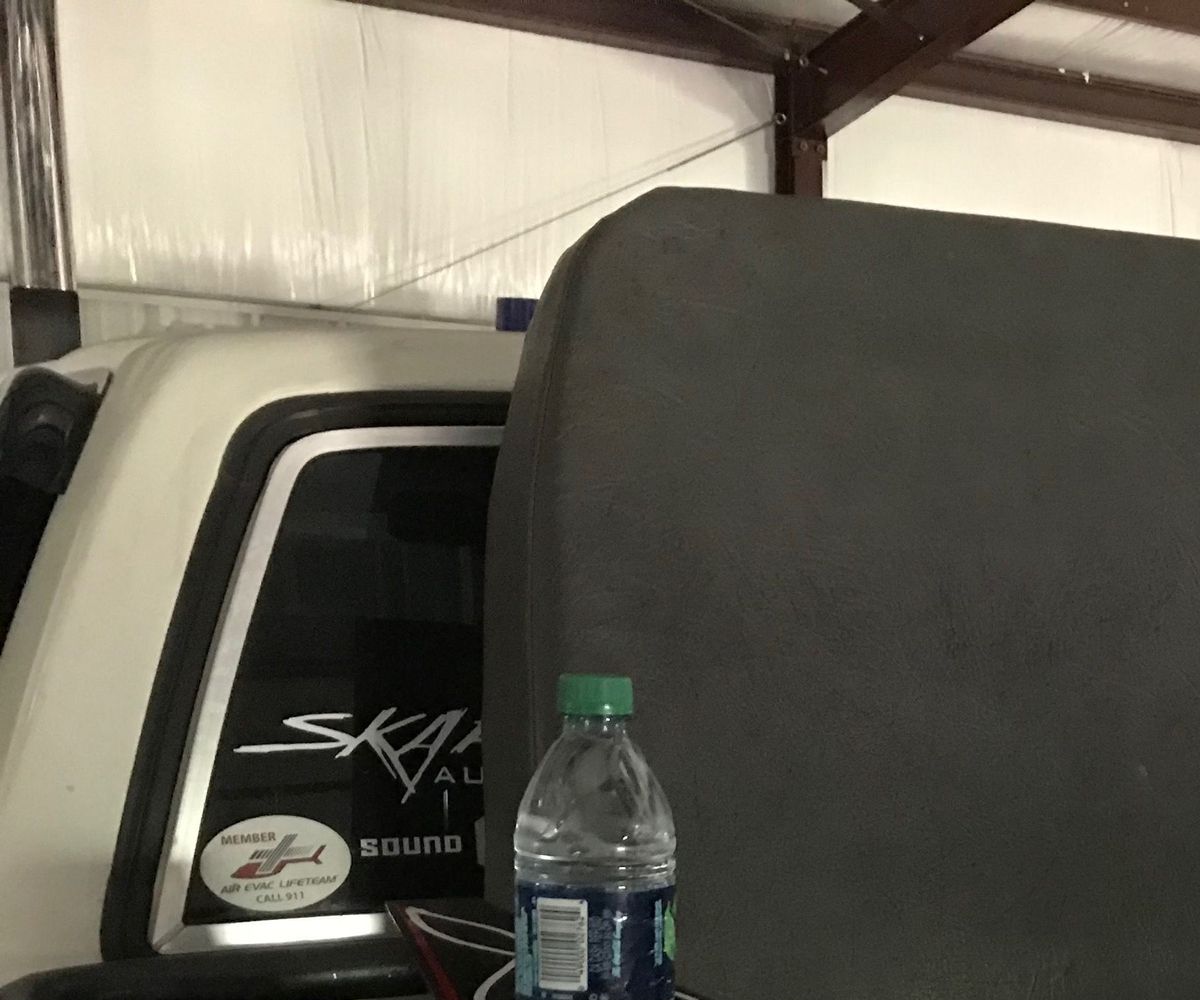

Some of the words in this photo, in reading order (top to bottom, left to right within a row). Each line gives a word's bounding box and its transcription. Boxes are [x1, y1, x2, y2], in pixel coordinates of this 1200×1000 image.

[220, 832, 276, 846] MEMBER
[360, 835, 463, 857] SOUND
[220, 882, 242, 894] AIR
[244, 880, 275, 892] EVAC
[279, 875, 338, 889] LIFETEAM
[256, 893, 283, 904] CALL
[285, 891, 305, 901] 911
